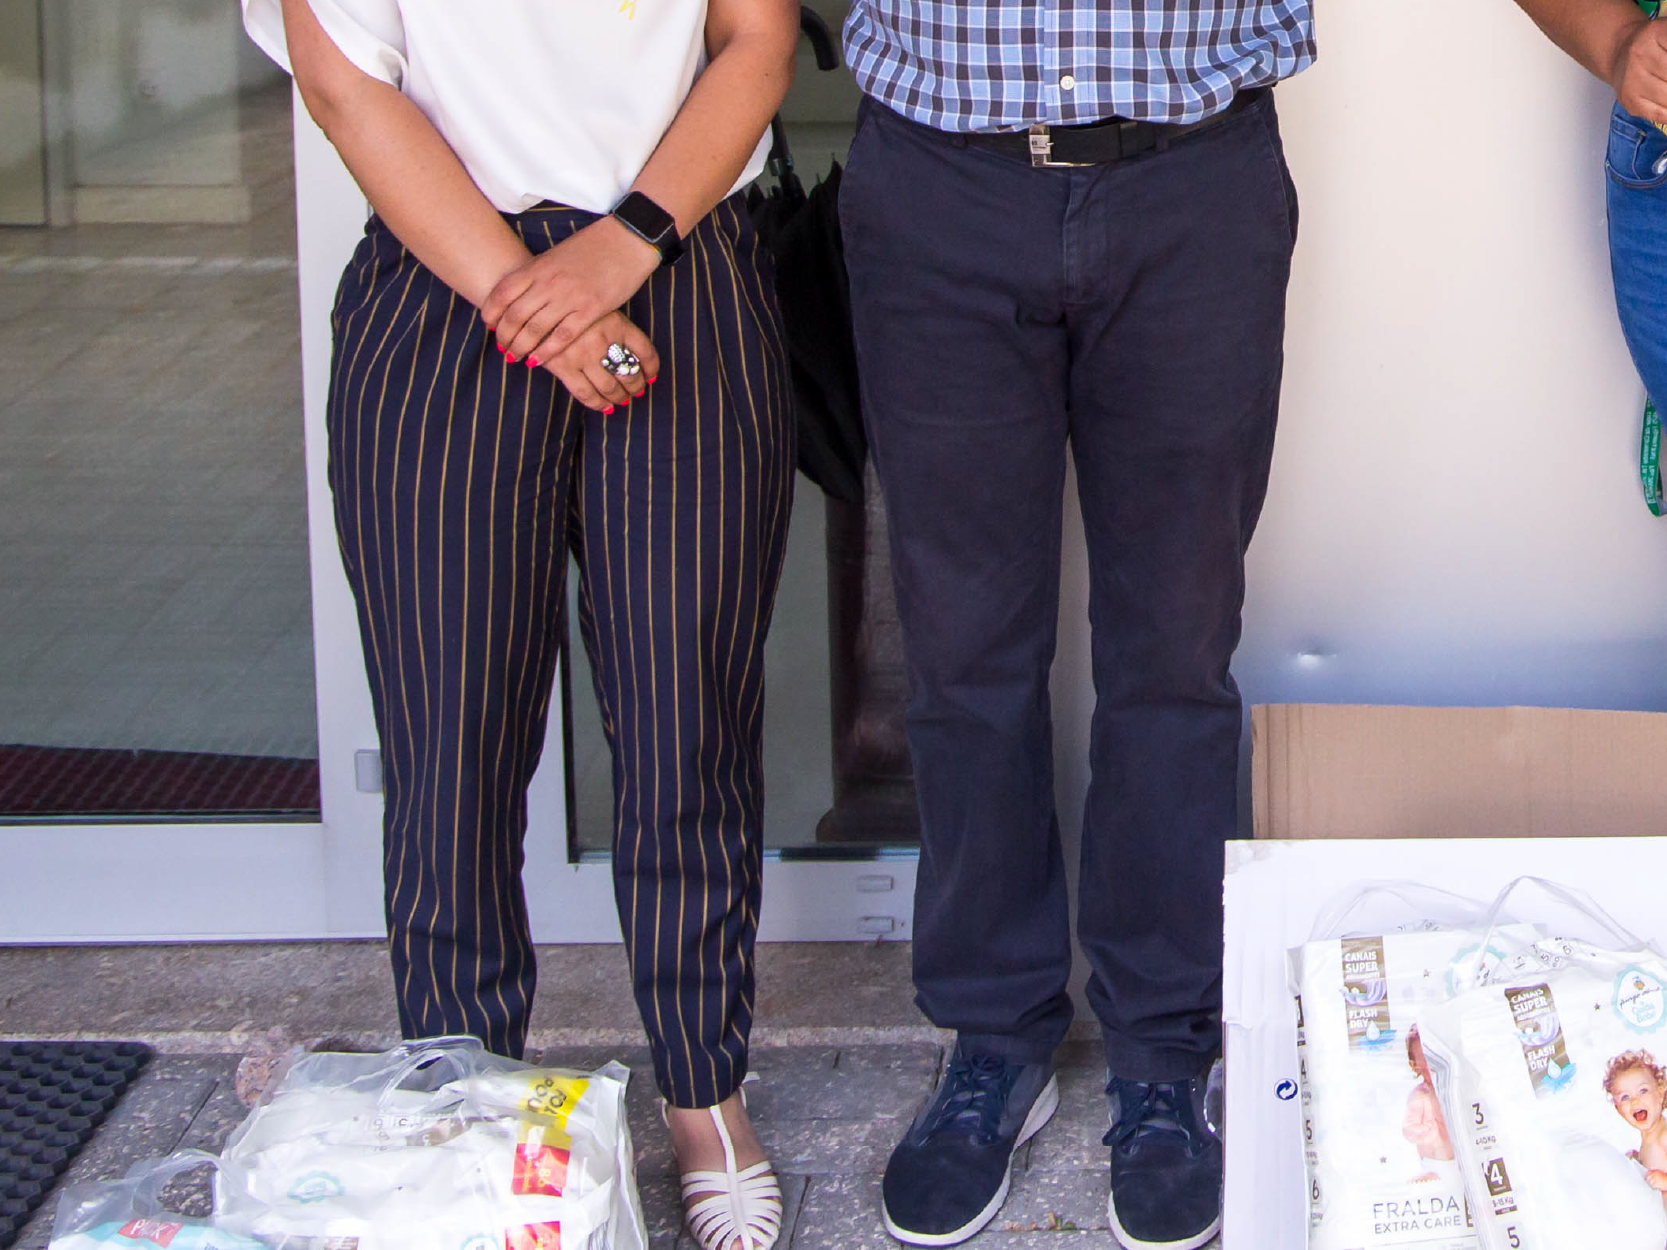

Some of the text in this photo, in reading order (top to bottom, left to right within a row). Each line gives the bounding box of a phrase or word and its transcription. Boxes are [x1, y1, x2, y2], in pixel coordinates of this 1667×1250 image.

[1345, 961, 1379, 974] SUPER
[1513, 996, 1548, 1013] SUPER
[1349, 1019, 1369, 1030] DRY
[1527, 1045, 1556, 1062] FLASH
[1529, 1056, 1548, 1072] DRY
[1472, 1103, 1484, 1125] 3
[1305, 1119, 1313, 1140] 5
[1491, 1163, 1503, 1185] 4
[1312, 1177, 1320, 1200] 6
[1373, 1195, 1460, 1219] FRALDA
[1375, 1214, 1462, 1235] EXTRA CARE
[1507, 1226, 1520, 1248] 5
